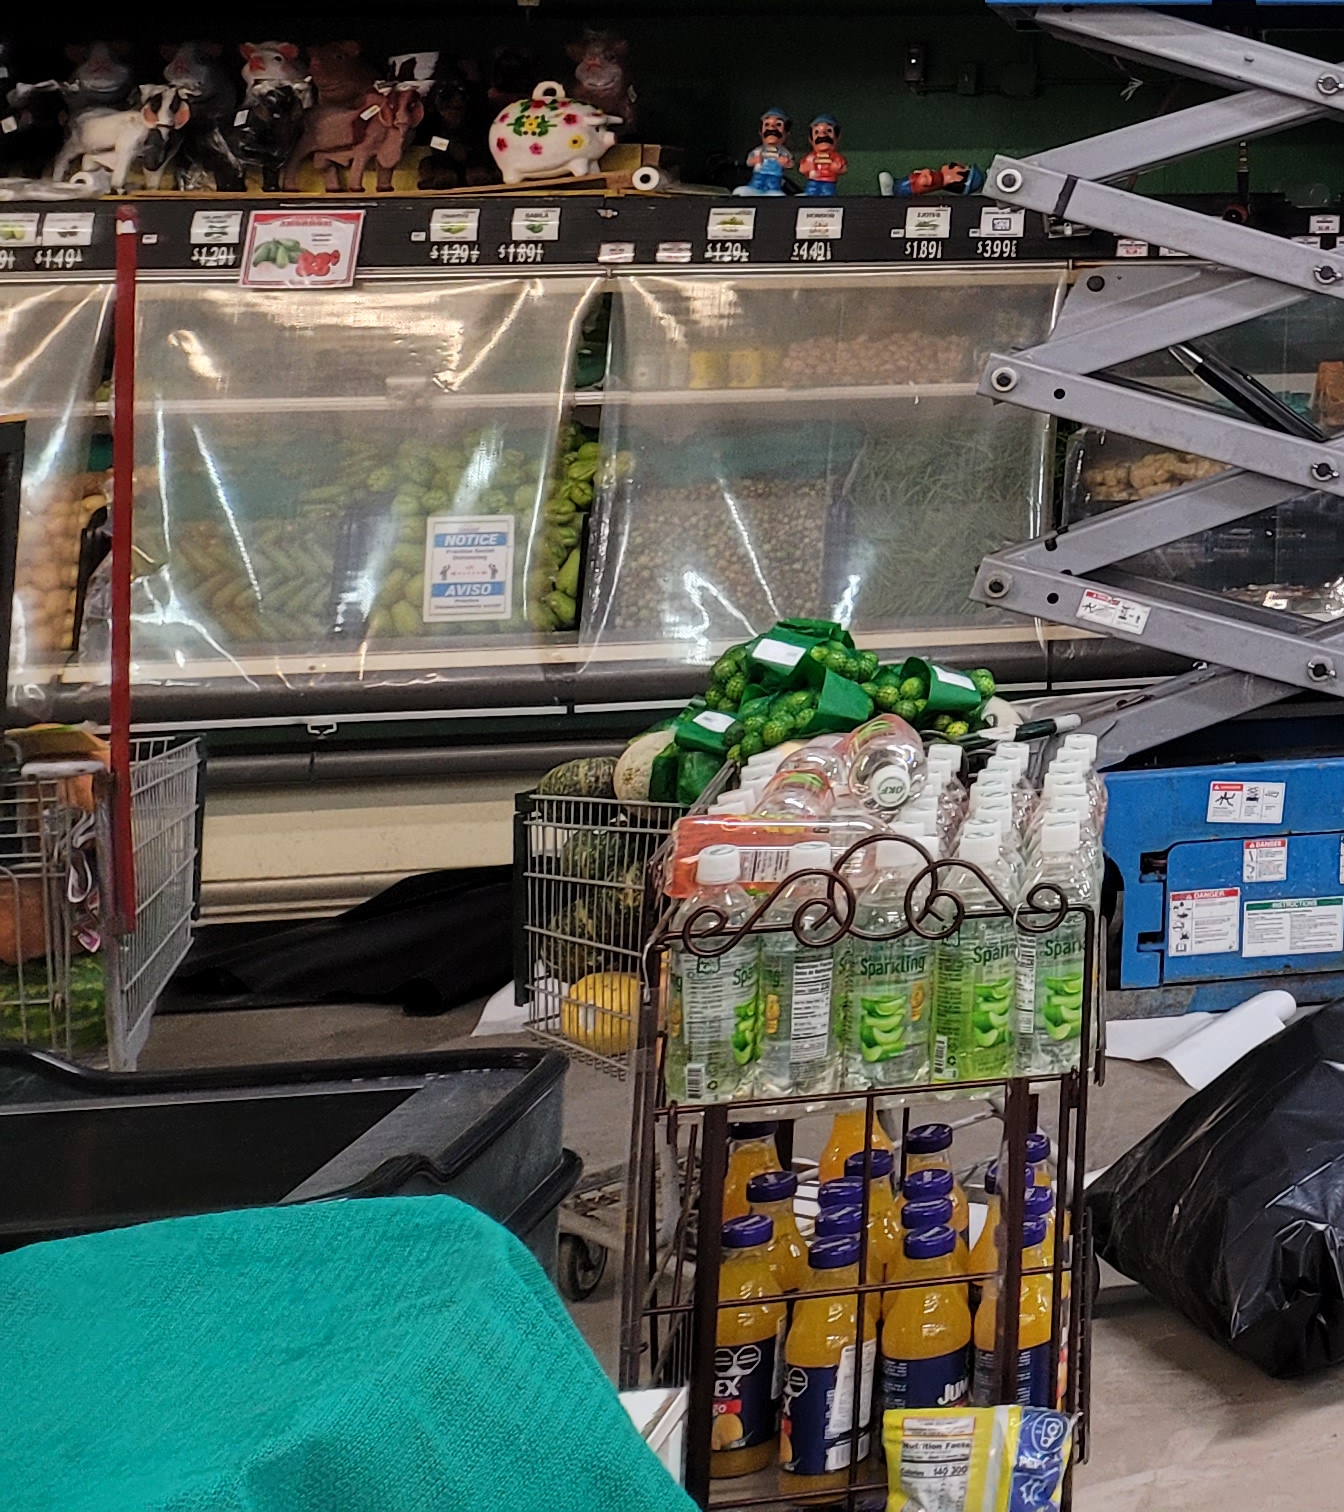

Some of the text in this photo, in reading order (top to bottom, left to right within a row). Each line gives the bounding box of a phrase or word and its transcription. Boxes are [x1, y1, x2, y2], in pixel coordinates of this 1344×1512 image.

[444, 533, 500, 546] NOTICE
[444, 583, 492, 597] AVISO
[1255, 840, 1282, 848] DANGER
[1193, 890, 1225, 899] DANGER
[860, 954, 926, 980] Sparkling
[902, 1441, 942, 1450] Nutition
